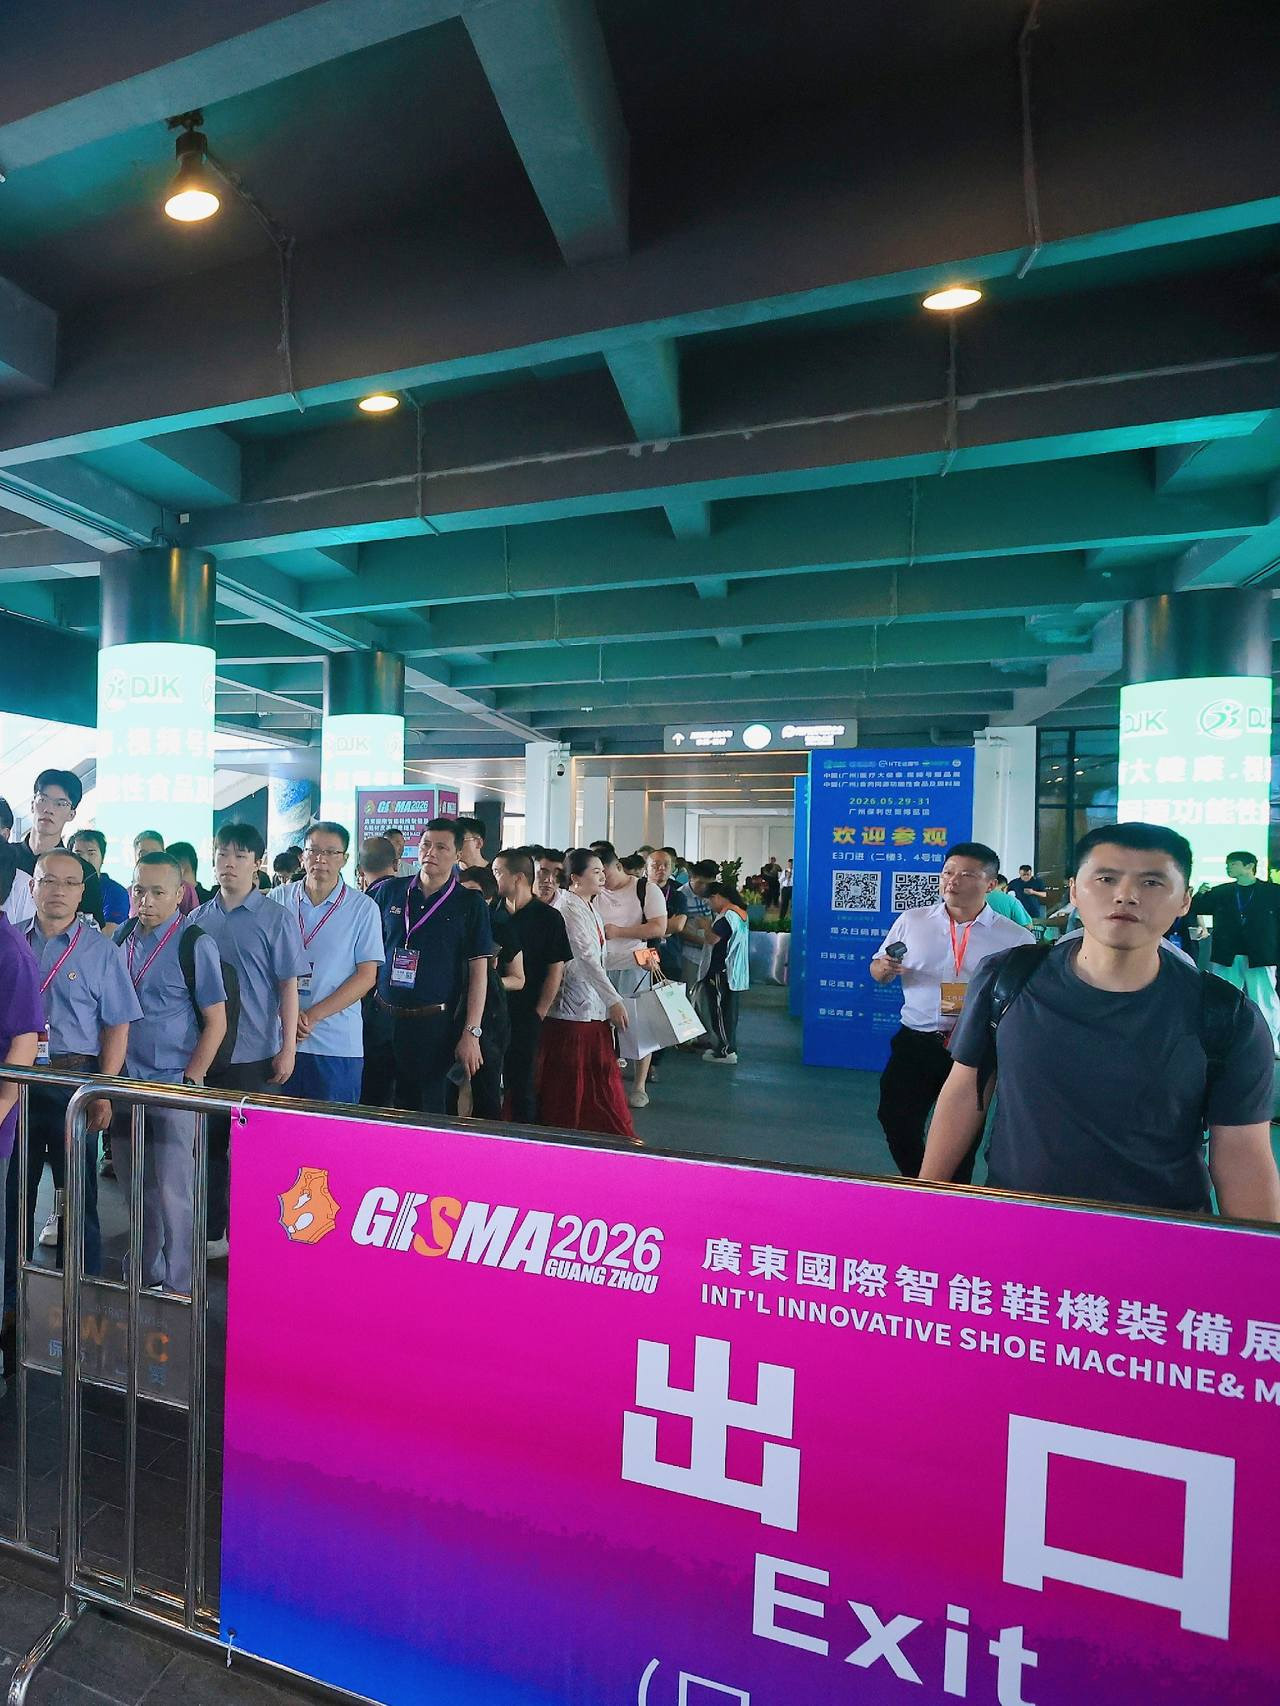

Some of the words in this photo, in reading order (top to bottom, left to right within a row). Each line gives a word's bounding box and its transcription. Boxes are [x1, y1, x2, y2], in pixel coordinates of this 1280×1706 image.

[130, 674, 181, 698] DJK
[832, 826, 948, 846] 欢迎参观
[544, 1257, 606, 1287] GUANG
[607, 1270, 660, 1295] ZHOU
[550, 1214, 666, 1274] 2026
[700, 1283, 771, 1315] INT'L
[777, 1295, 952, 1347] INNOVATIVE
[958, 1327, 1046, 1364] SHOE
[701, 1237, 1280, 1363] 廣東國際智能鞋機裝備展
[620, 1335, 1237, 1641] 出口
[751, 1552, 1041, 1706] Exit
